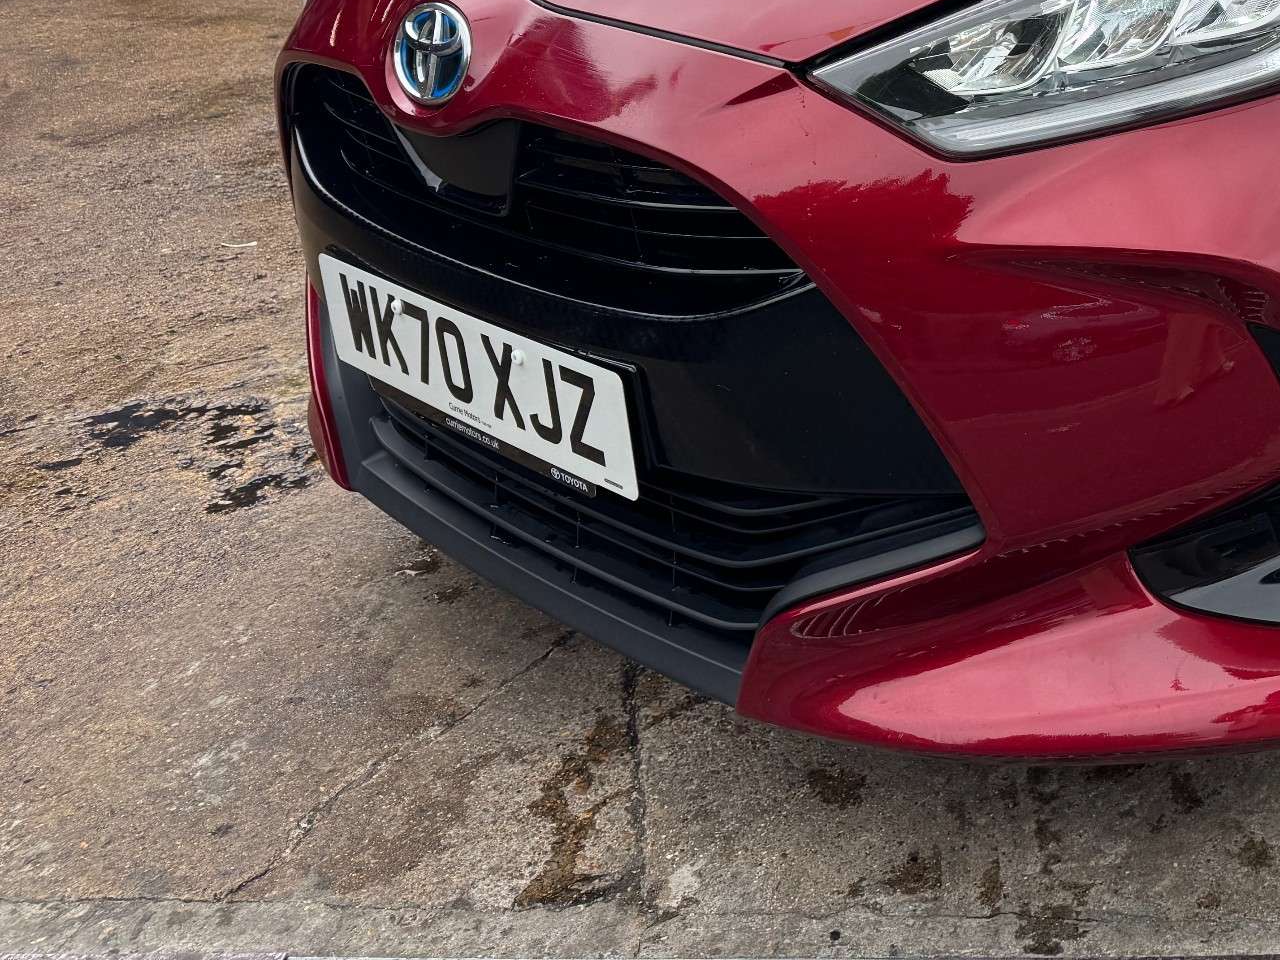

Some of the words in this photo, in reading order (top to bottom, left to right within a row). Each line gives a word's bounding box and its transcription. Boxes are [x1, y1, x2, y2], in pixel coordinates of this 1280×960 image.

[338, 271, 474, 405] WK70
[480, 332, 607, 468] XJZ
[560, 473, 588, 493] TOYOTA
